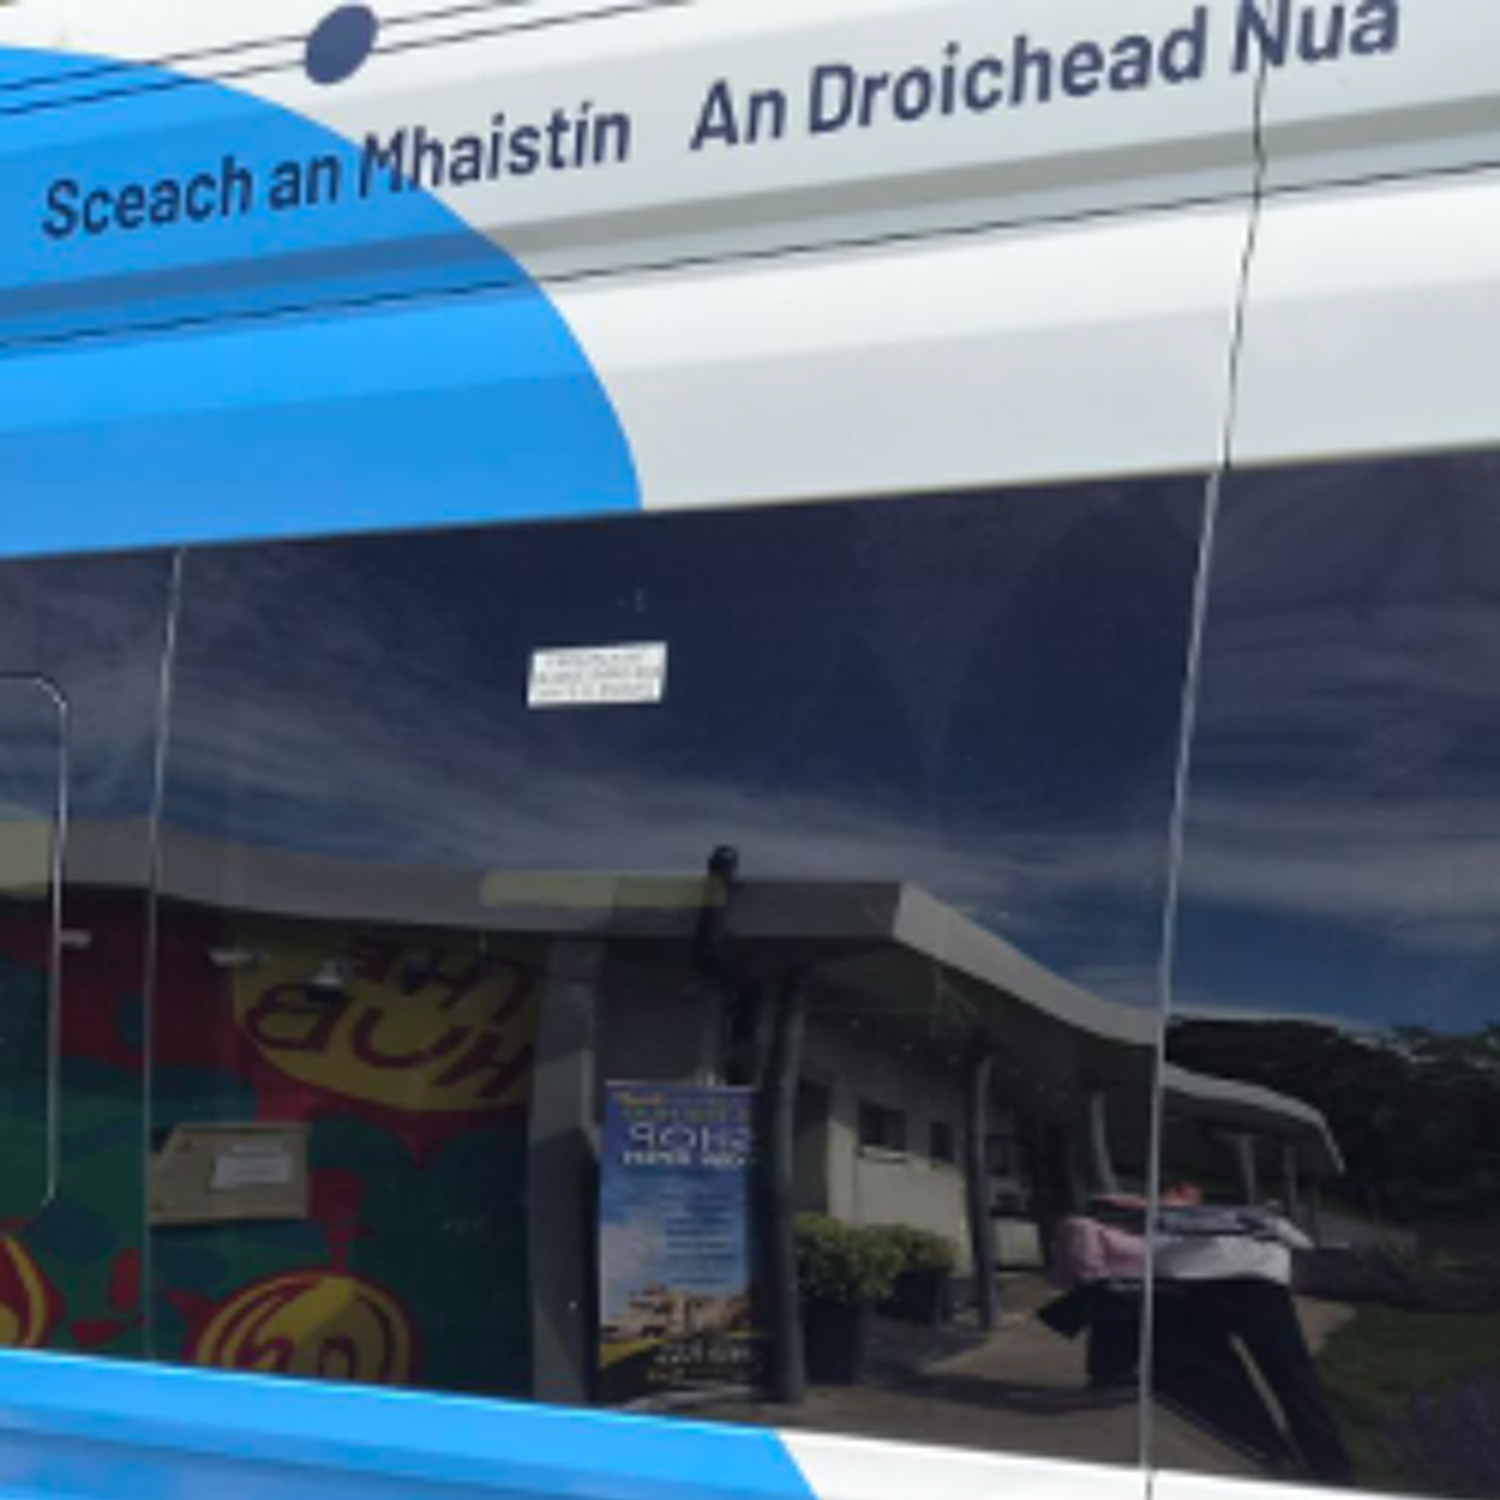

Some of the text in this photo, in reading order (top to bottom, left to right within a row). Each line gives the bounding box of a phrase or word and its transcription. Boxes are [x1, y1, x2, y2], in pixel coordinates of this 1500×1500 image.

[690, 0, 1400, 150] An Droichead Nua
[41, 102, 631, 239] Sceach an Mhaistín
